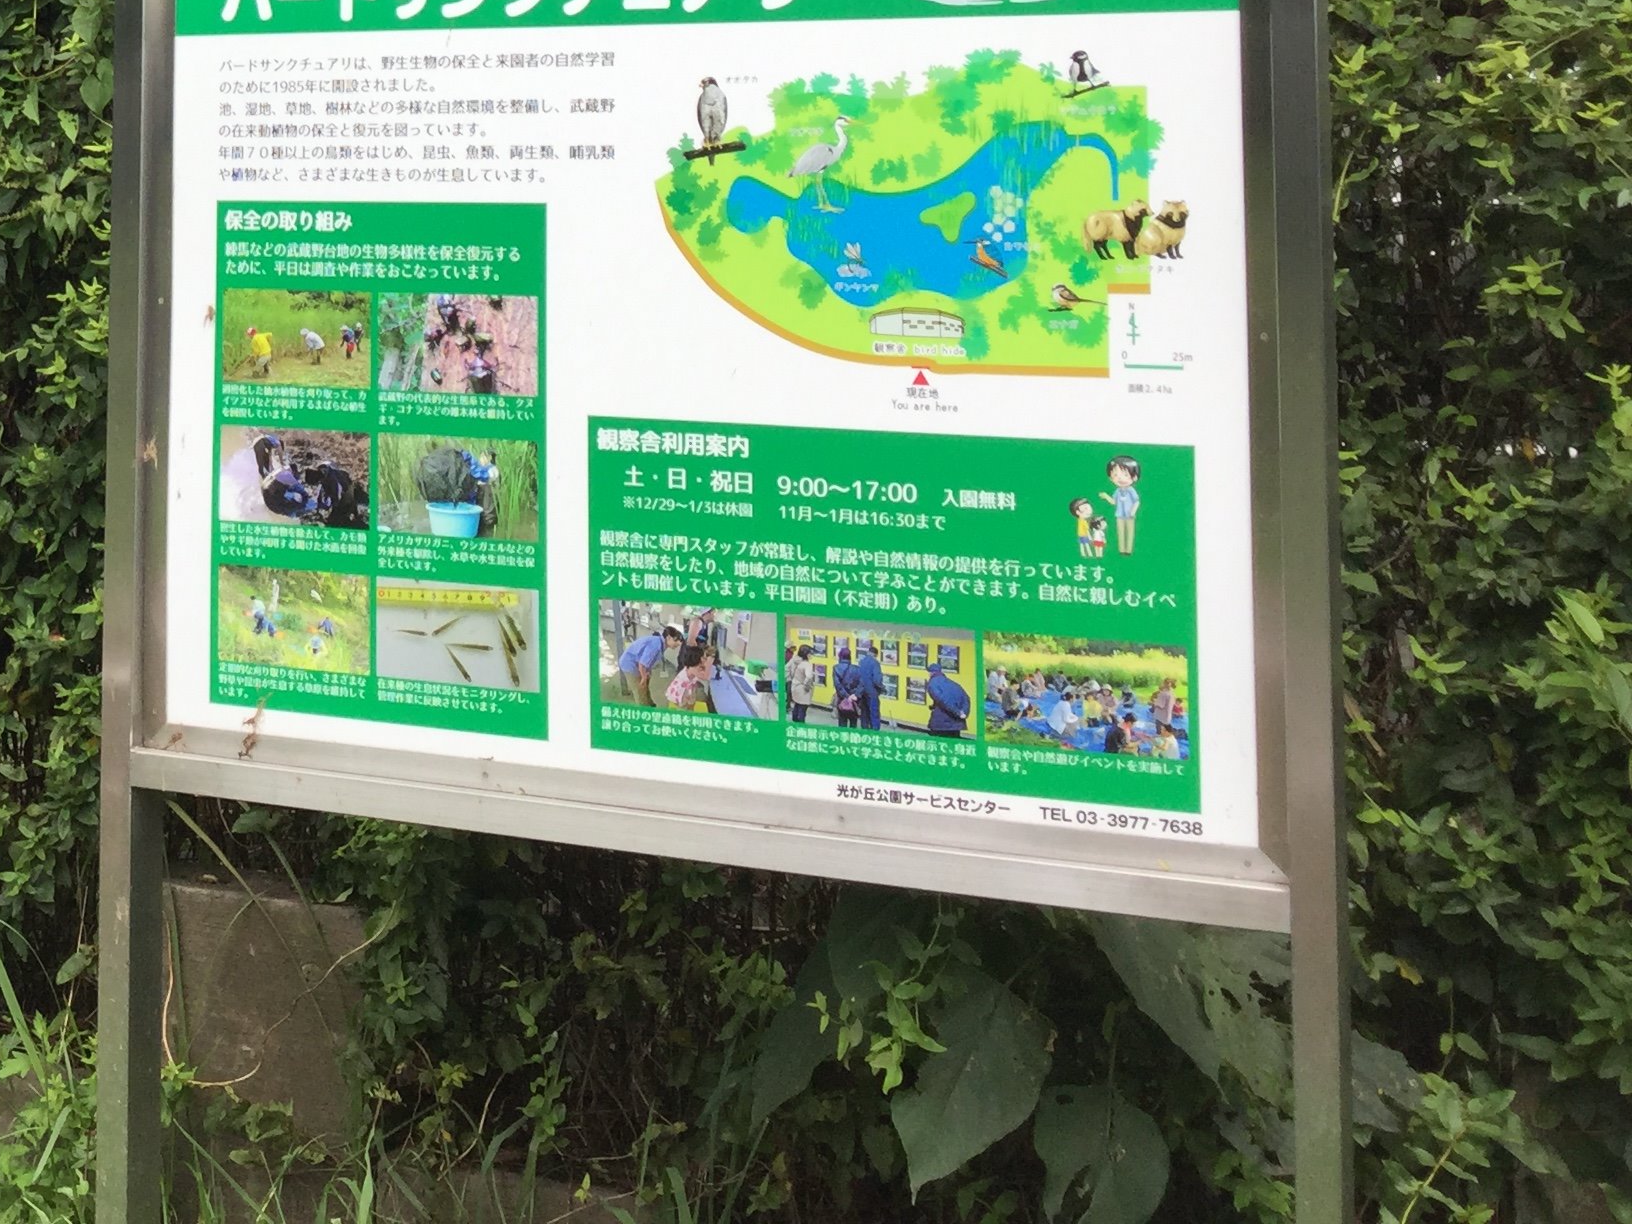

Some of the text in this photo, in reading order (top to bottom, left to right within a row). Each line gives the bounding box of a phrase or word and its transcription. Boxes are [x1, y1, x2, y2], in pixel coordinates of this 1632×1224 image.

[219, 79, 436, 95] のために1985年に開設されました。
[224, 210, 352, 232] 保全の取り組み
[225, 260, 499, 281] ために、平日は調査や作業をおこなっています。
[914, 343, 937, 356] bird
[941, 344, 965, 356] hide
[1172, 351, 1193, 363] 25m
[906, 387, 939, 400] 現在地
[891, 400, 958, 413] You are here
[378, 416, 400, 426] ます。
[597, 427, 749, 458] 観察舎利用案内
[624, 466, 753, 494] 土・日・祝日
[942, 488, 1016, 511] 入園無料
[600, 530, 1114, 584] 観察舎に専門スタッフが常駐し、解説や自然情報の提供を行っています。
[219, 687, 249, 700] います。
[786, 739, 966, 770] な自然について学ぶことができます。
[988, 760, 1028, 775] います。
[837, 784, 1203, 836] 光が丘公園サービスセンター TEL 03-3977-7638
